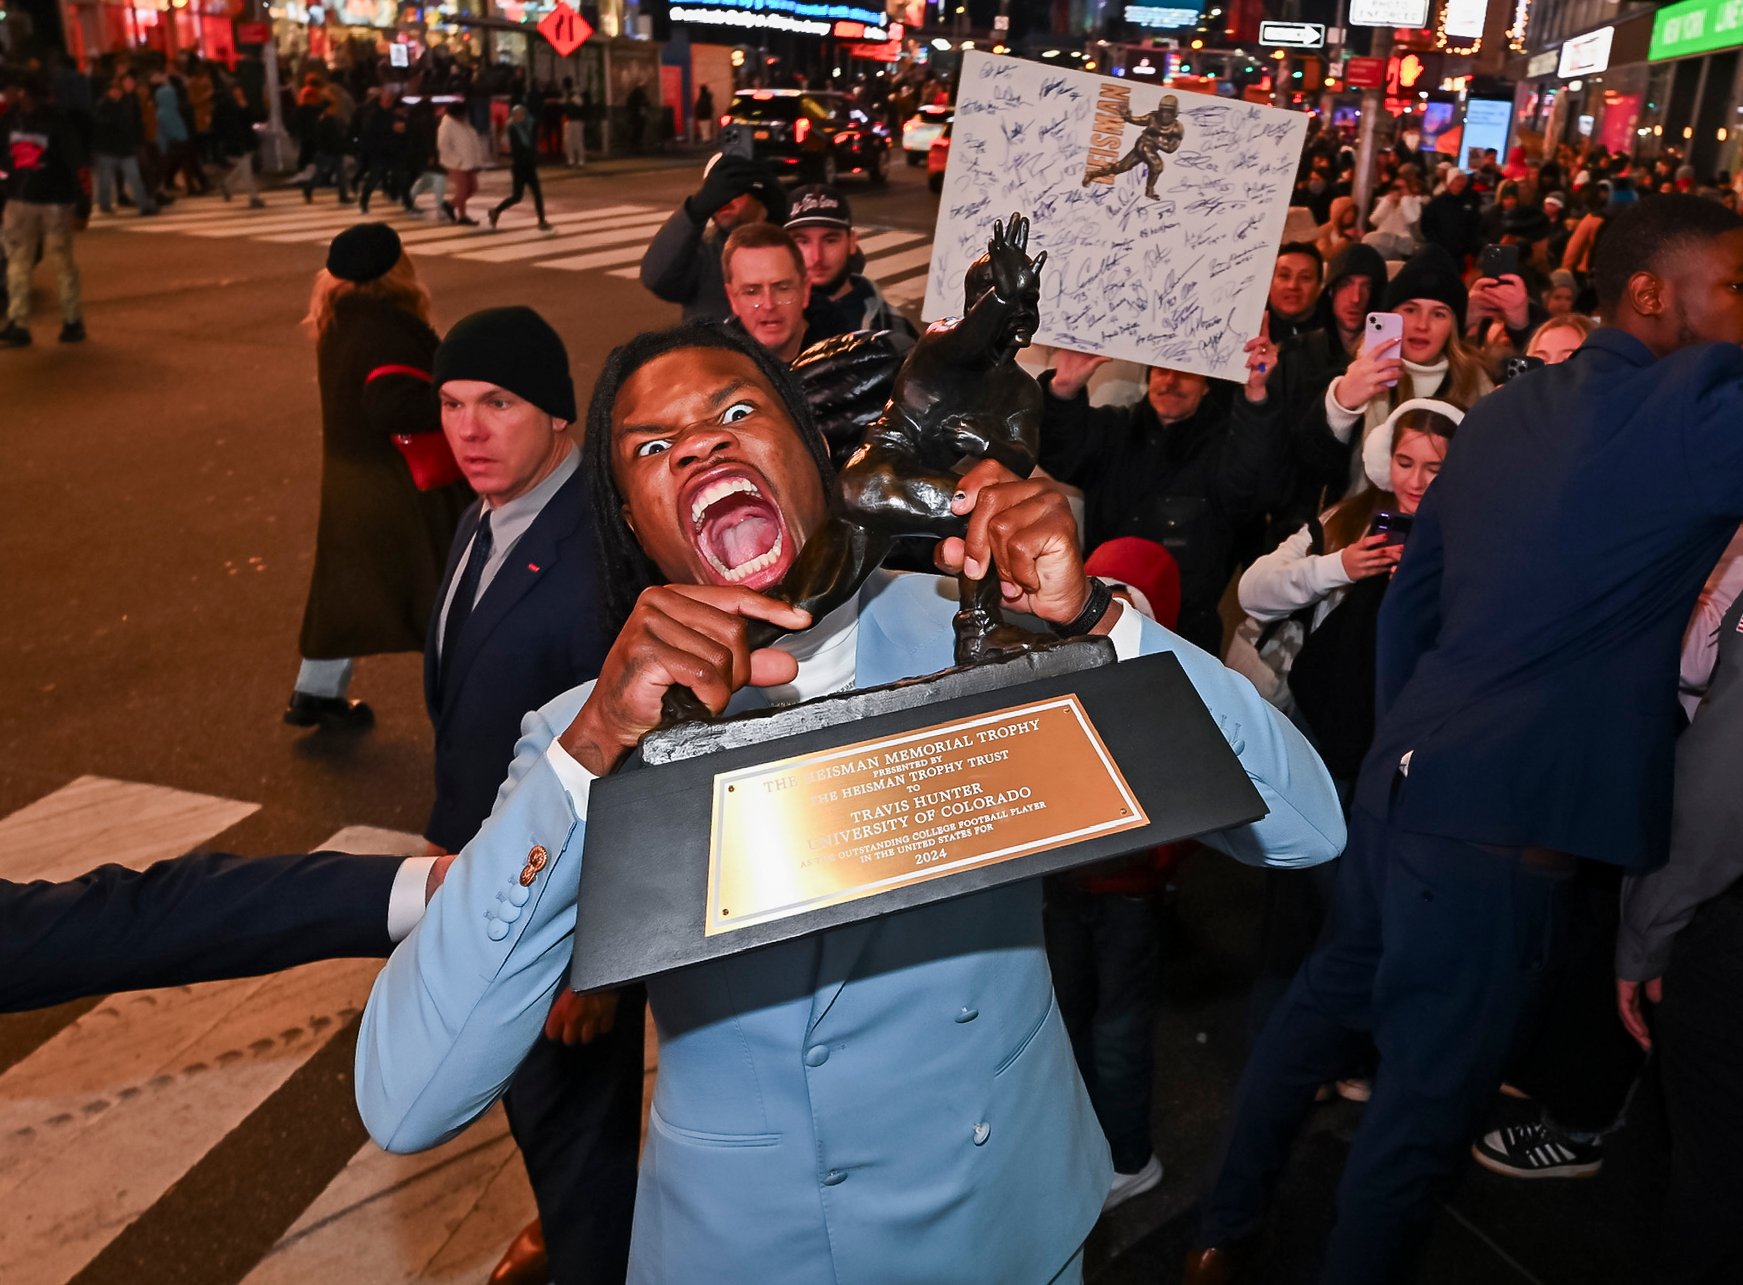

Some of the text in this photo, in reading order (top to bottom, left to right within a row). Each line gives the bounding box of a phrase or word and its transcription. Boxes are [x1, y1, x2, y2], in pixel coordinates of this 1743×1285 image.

[763, 775, 799, 793] THE
[885, 735, 974, 765] MEMORIAL
[976, 718, 1040, 744] TROPHY
[842, 775, 905, 799] HEISMAN
[909, 760, 964, 783] TROPHY
[967, 750, 1009, 769] TRUST
[873, 755, 943, 778] PRESENTED BY
[850, 782, 984, 824] TRAVIS HUNTER
[906, 783, 921, 793] TO
[914, 809, 936, 825] OF
[941, 786, 1032, 818] COLORADO
[838, 835, 910, 860] OUTSTANDING
[912, 823, 957, 841] COLLEGE
[958, 810, 1009, 829] FOOTBALL
[1010, 801, 1047, 816] PLAYER
[860, 823, 994, 864] IN THE UNITED STATES FOR
[914, 848, 948, 865] 2024
